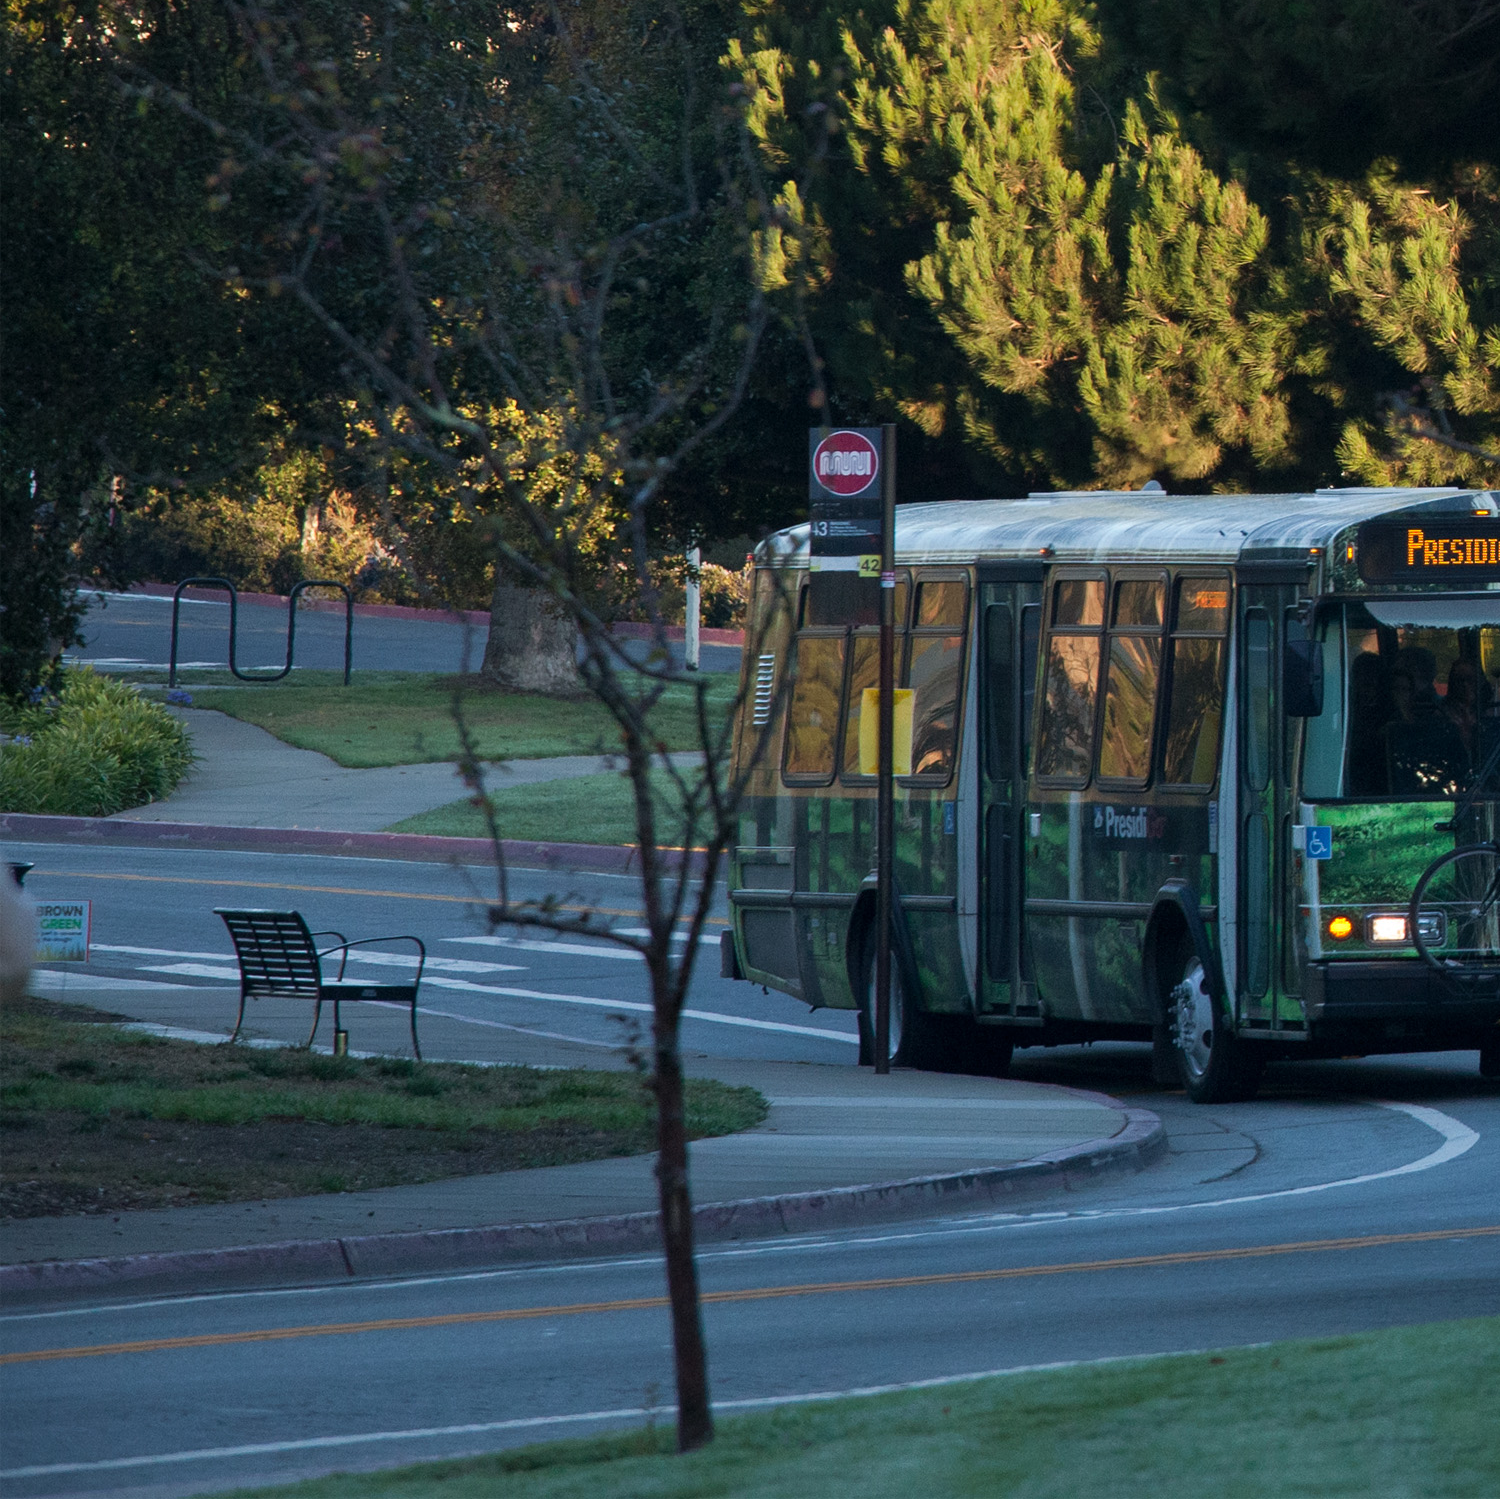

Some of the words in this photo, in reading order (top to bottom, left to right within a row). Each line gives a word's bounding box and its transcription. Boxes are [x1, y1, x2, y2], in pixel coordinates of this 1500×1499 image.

[820, 451, 871, 476] MUNI
[812, 521, 828, 537] 43
[861, 559, 880, 572] 42
[41, 919, 81, 930] GREEN
